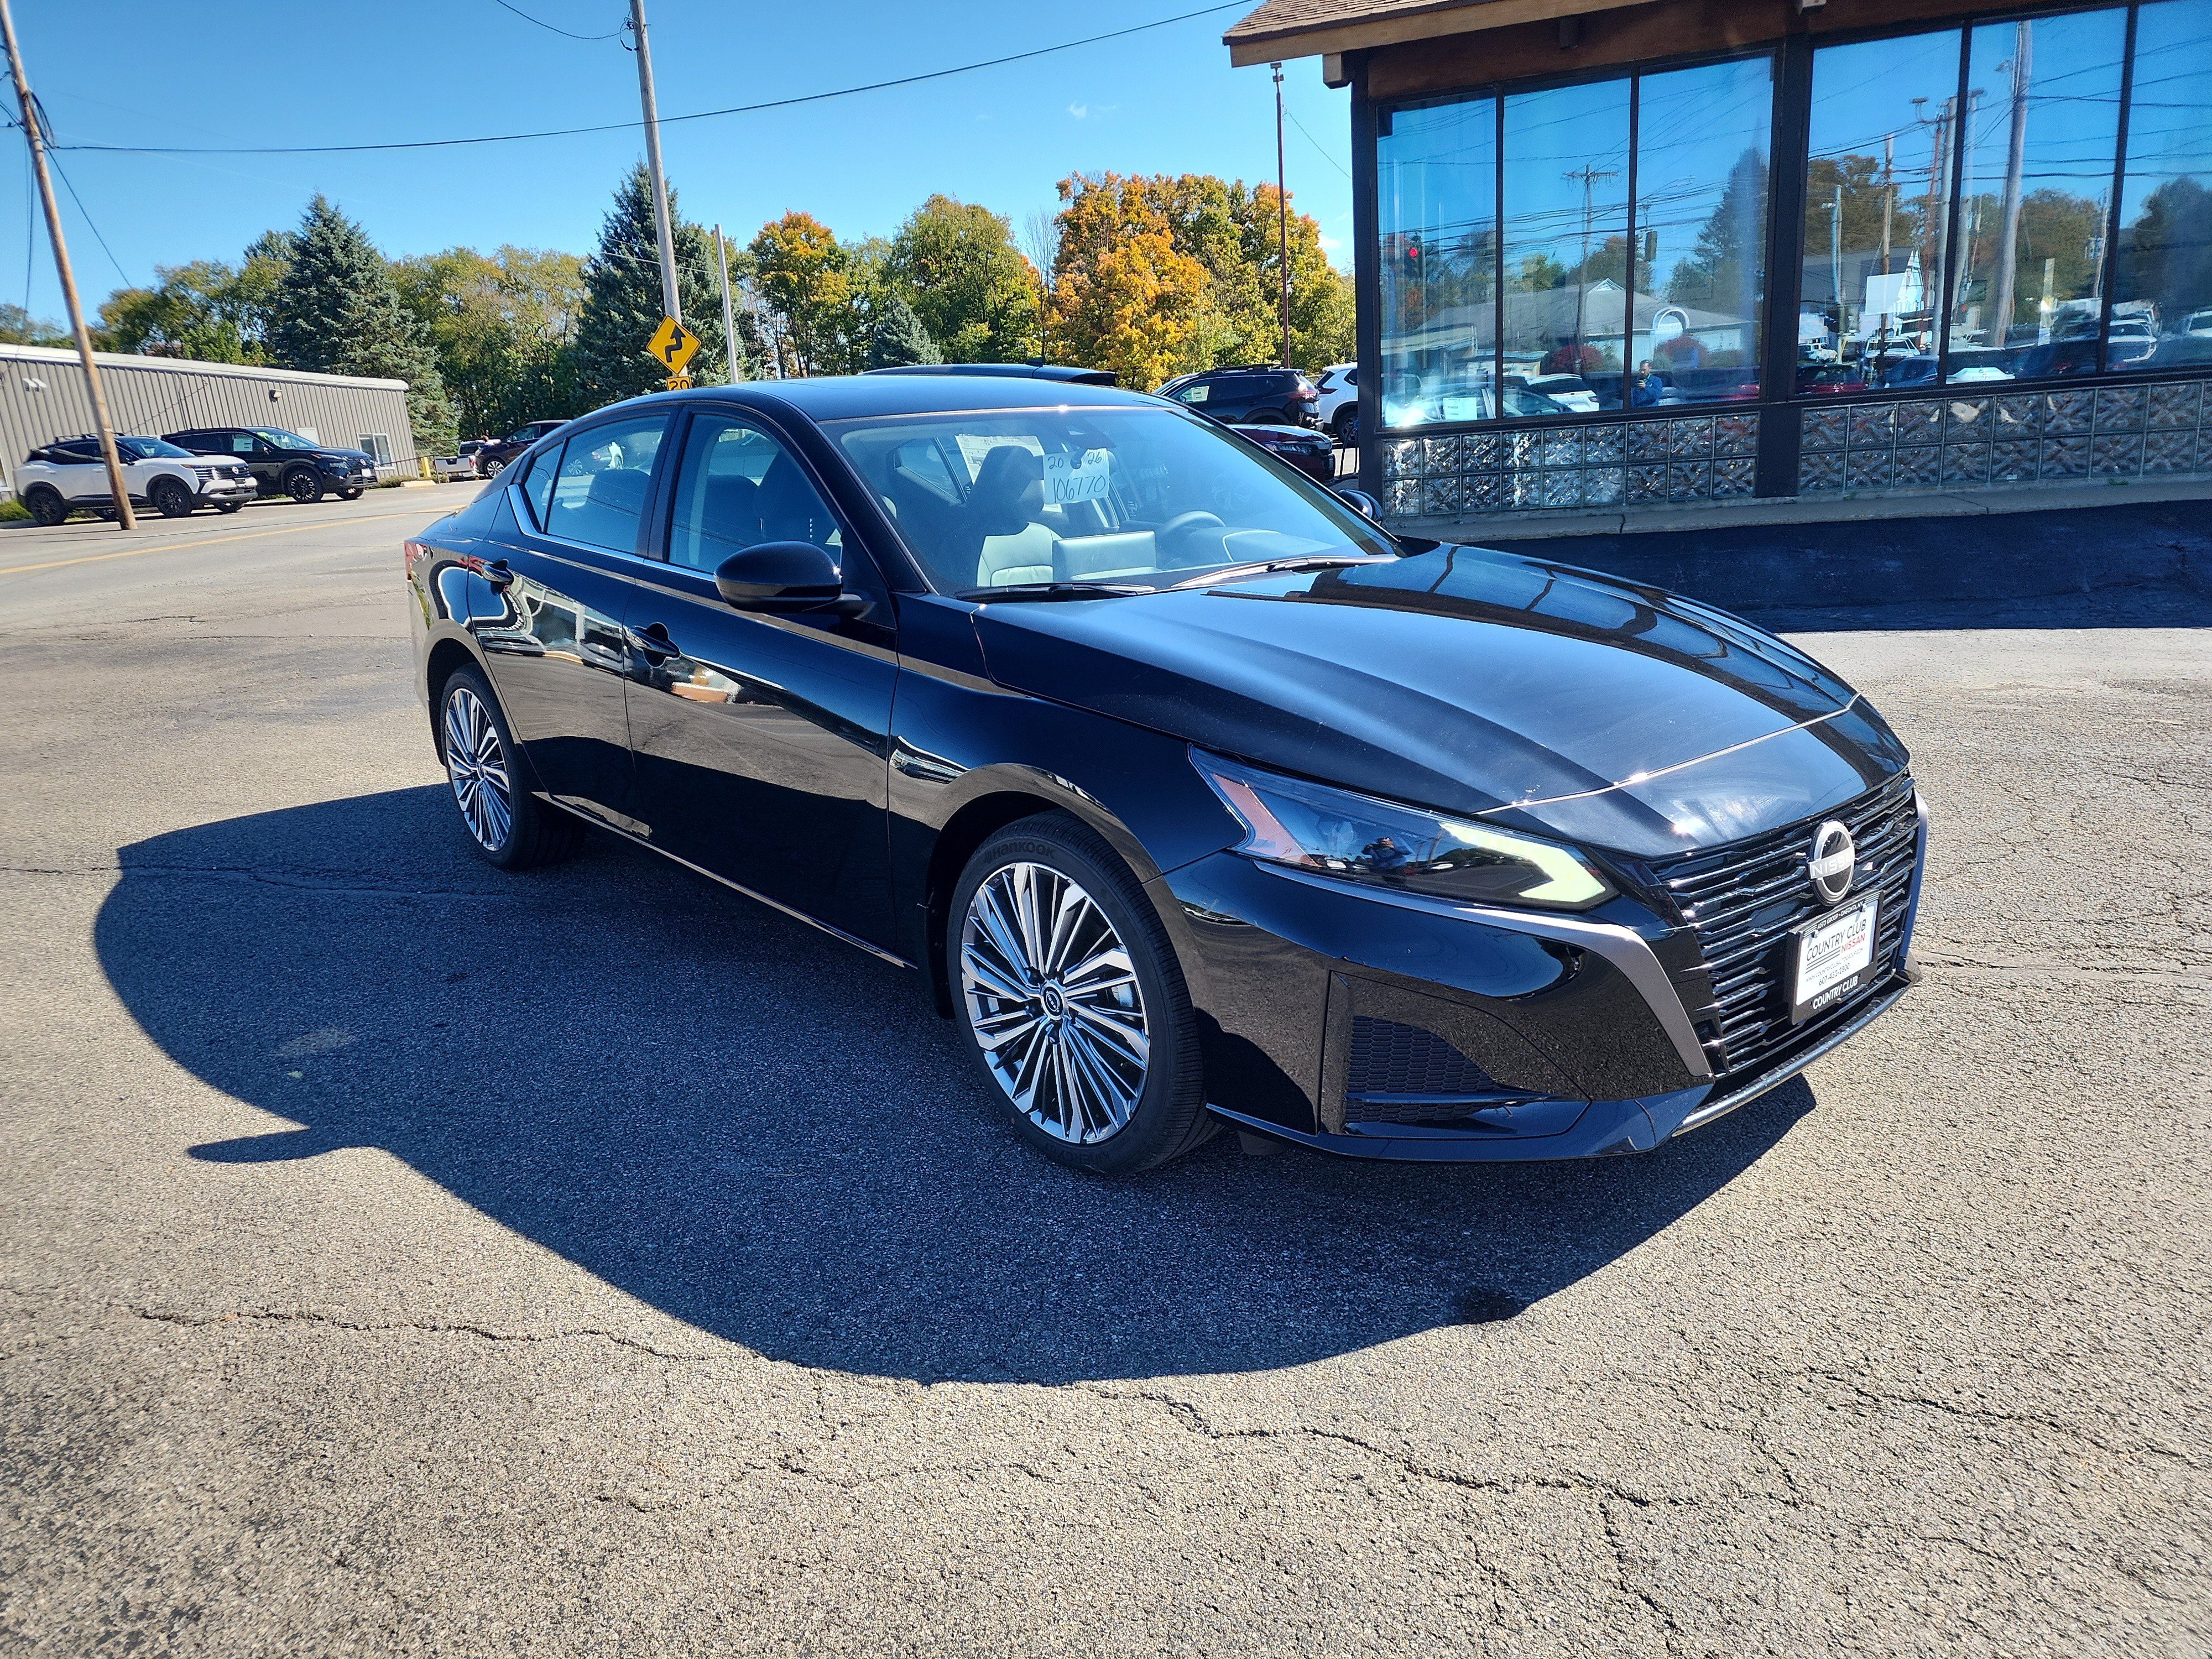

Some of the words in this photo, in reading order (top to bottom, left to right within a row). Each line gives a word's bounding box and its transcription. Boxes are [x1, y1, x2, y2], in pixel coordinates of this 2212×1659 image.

[669, 379, 690, 390] 20
[1047, 456, 1064, 469] 20
[1087, 451, 1102, 465] 26
[1053, 474, 1106, 503] 106770
[1807, 930, 1845, 961] COUNTRY
[1847, 919, 1866, 939] CLUB
[1841, 933, 1865, 953] NISSAN
[1813, 984, 1843, 1010] COUNTRY
[1842, 975, 1858, 992] CLUB
